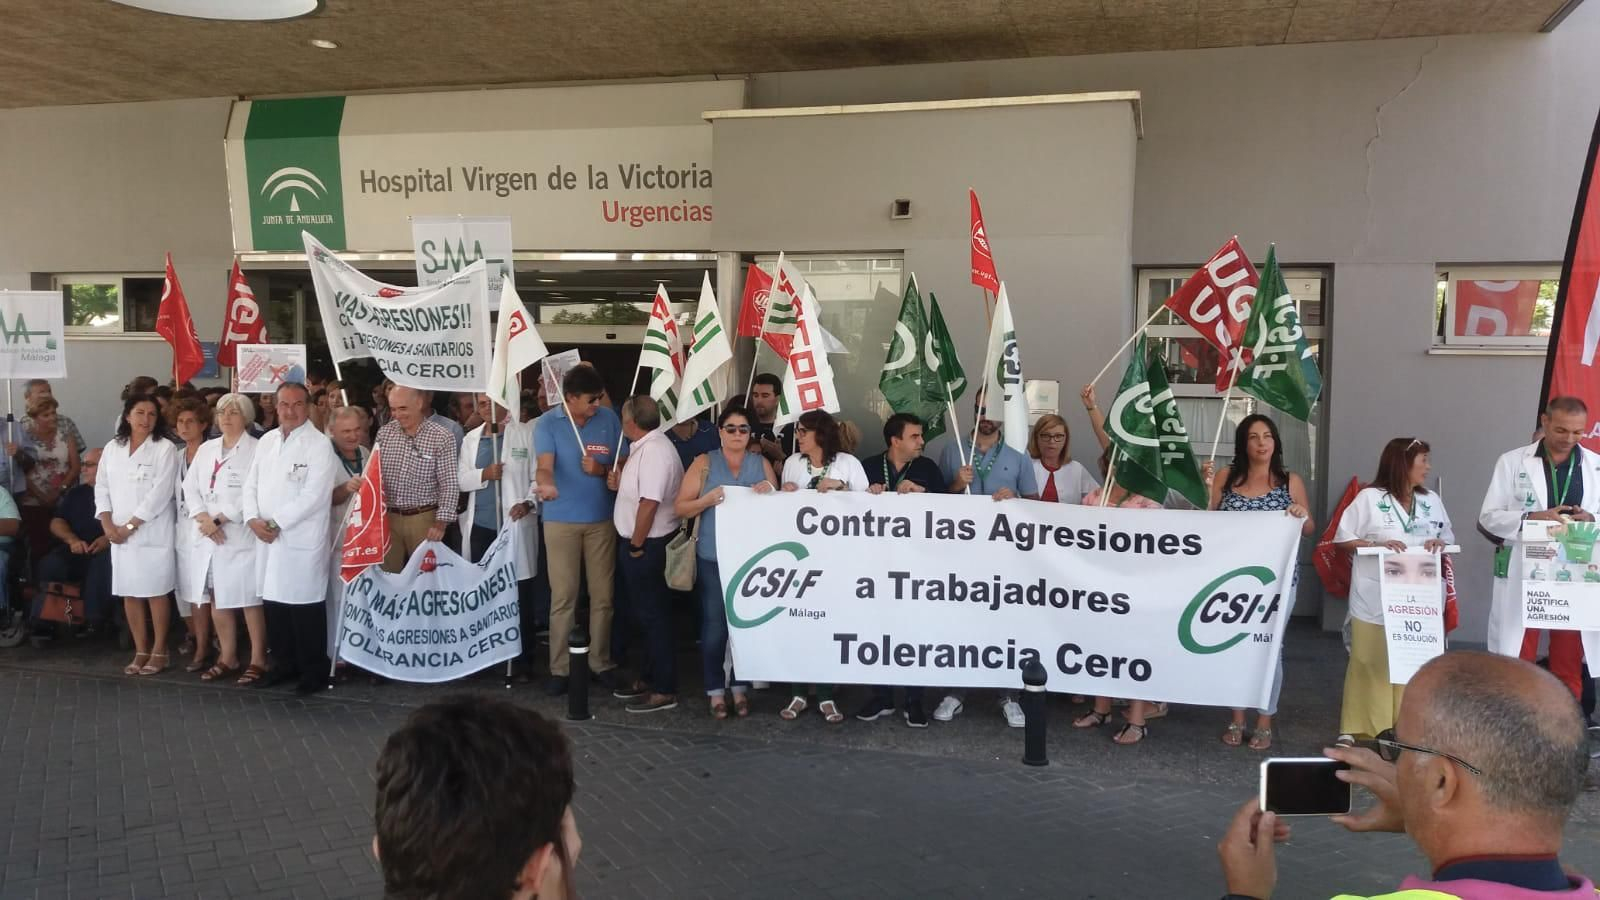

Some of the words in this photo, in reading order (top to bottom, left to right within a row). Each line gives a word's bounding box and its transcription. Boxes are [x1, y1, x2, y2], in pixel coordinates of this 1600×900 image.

[360, 167, 453, 199] Hospital
[461, 165, 537, 198] Virgen
[547, 164, 577, 191] de
[587, 164, 609, 190] la
[617, 162, 713, 190] Victoria
[262, 215, 284, 225] JUNTA
[285, 215, 295, 225] DE
[602, 199, 713, 228] Urgencias
[412, 341, 474, 357] SANITARIOS
[406, 362, 475, 379] CERO!!
[796, 506, 911, 538] Contra
[925, 510, 976, 540] las
[988, 513, 1203, 556] Agresiones
[855, 577, 875, 599] a
[887, 570, 1131, 615] Trabajadores
[1406, 594, 1417, 603] LA
[1527, 590, 1551, 598] NADA
[1527, 597, 1570, 606] JUSTIFICA
[789, 607, 826, 620] Málaga
[1387, 604, 1439, 617] AGRESIÓN
[1527, 605, 1546, 613] UNA
[1527, 612, 1571, 622] AGRESIÓN
[1404, 619, 1423, 633] NO
[387, 629, 458, 645] AGRESIONES
[460, 629, 470, 643] A
[1392, 633, 1402, 642] ES
[1403, 633, 1438, 644] SOLUCIÓN
[832, 633, 1041, 674] Tolerancia
[1056, 642, 1153, 682] Cero
